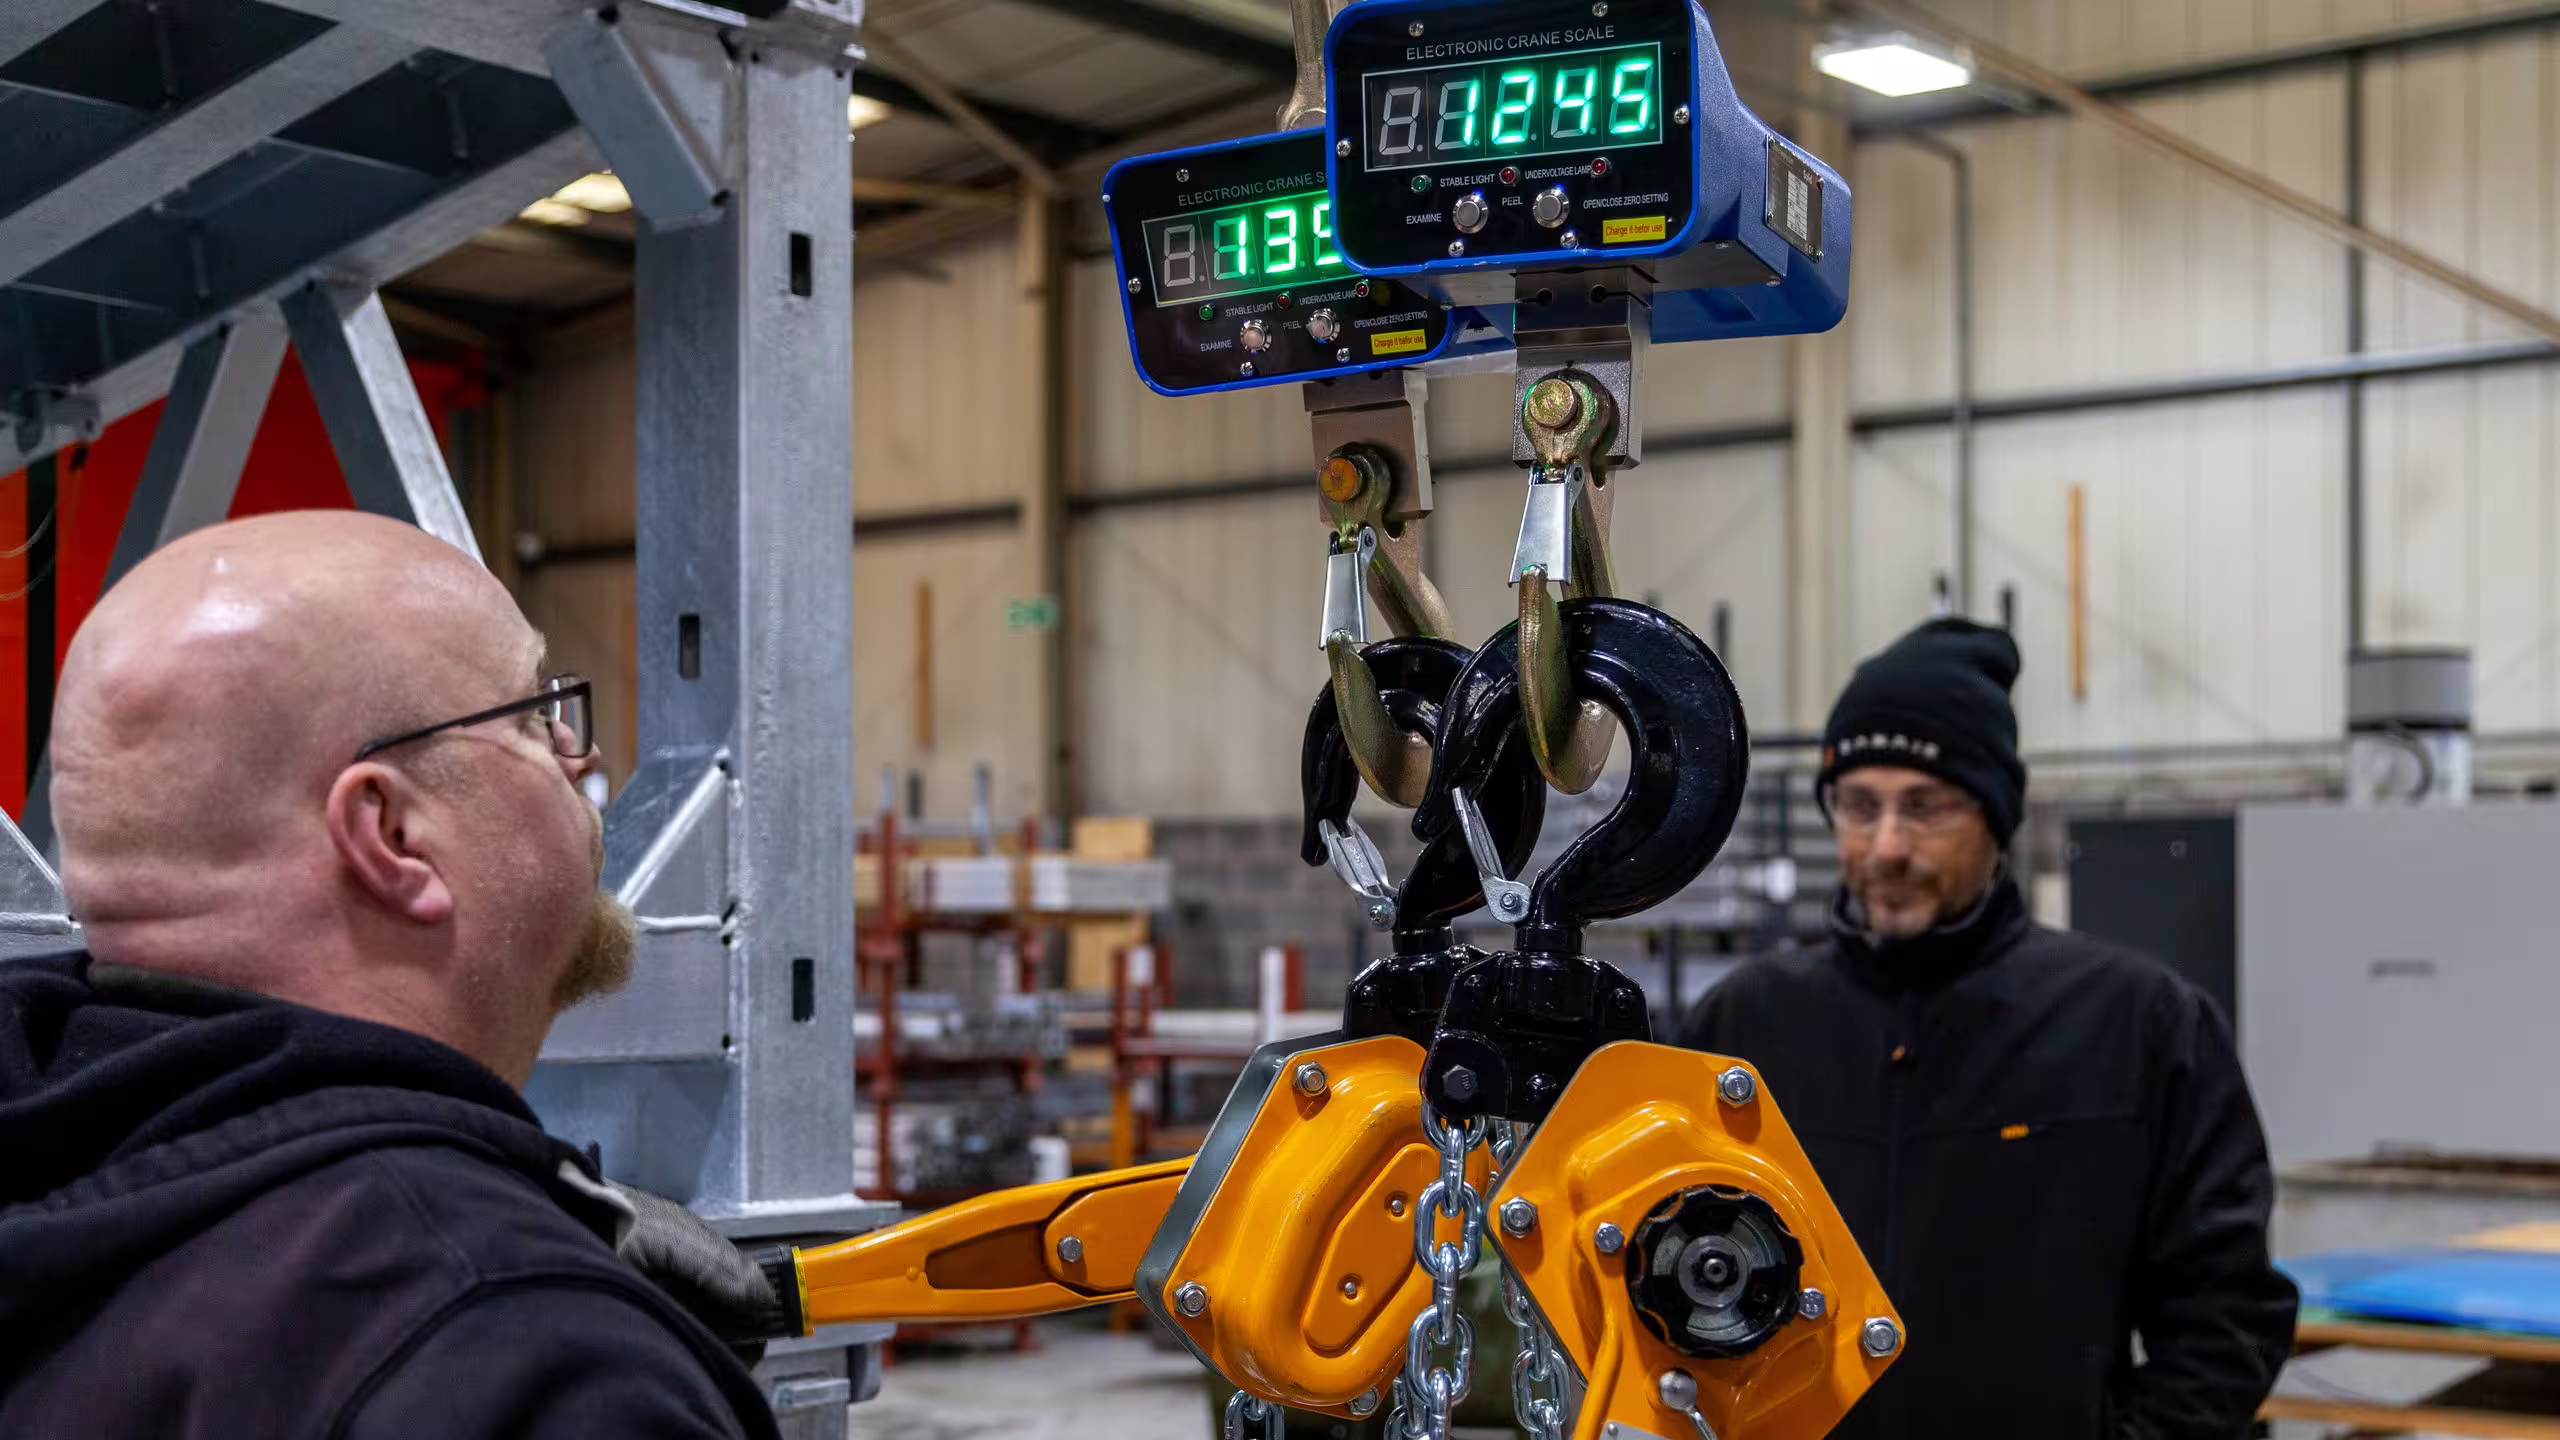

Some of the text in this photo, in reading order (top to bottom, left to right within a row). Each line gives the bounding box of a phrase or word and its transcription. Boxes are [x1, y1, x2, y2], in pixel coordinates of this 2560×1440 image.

[1406, 25, 1615, 61] ELECTRONIC CRANE SCALE
[1525, 165, 1592, 179] UNDERVOLTAGE LAMP
[1440, 174, 1495, 187] STABLE LIGHT
[1178, 171, 1328, 207] ELECTRONIC CRANE S
[1501, 196, 1523, 206] PEEL
[1624, 195, 1641, 206] ZERO
[1641, 192, 1669, 204] SETTING
[1406, 213, 1442, 225] EXAMINE
[1605, 226, 1628, 237] Charge
[1629, 225, 1634, 234] it
[1651, 224, 1663, 233] use
[1299, 291, 1342, 305] UNDERVOLTAGE
[1225, 302, 1274, 318] STABLE LIGHT
[1389, 314, 1404, 324] ZERO
[1404, 310, 1428, 321] SETTING
[1282, 320, 1302, 330] PEEL
[1200, 340, 1232, 351] EXAMINE
